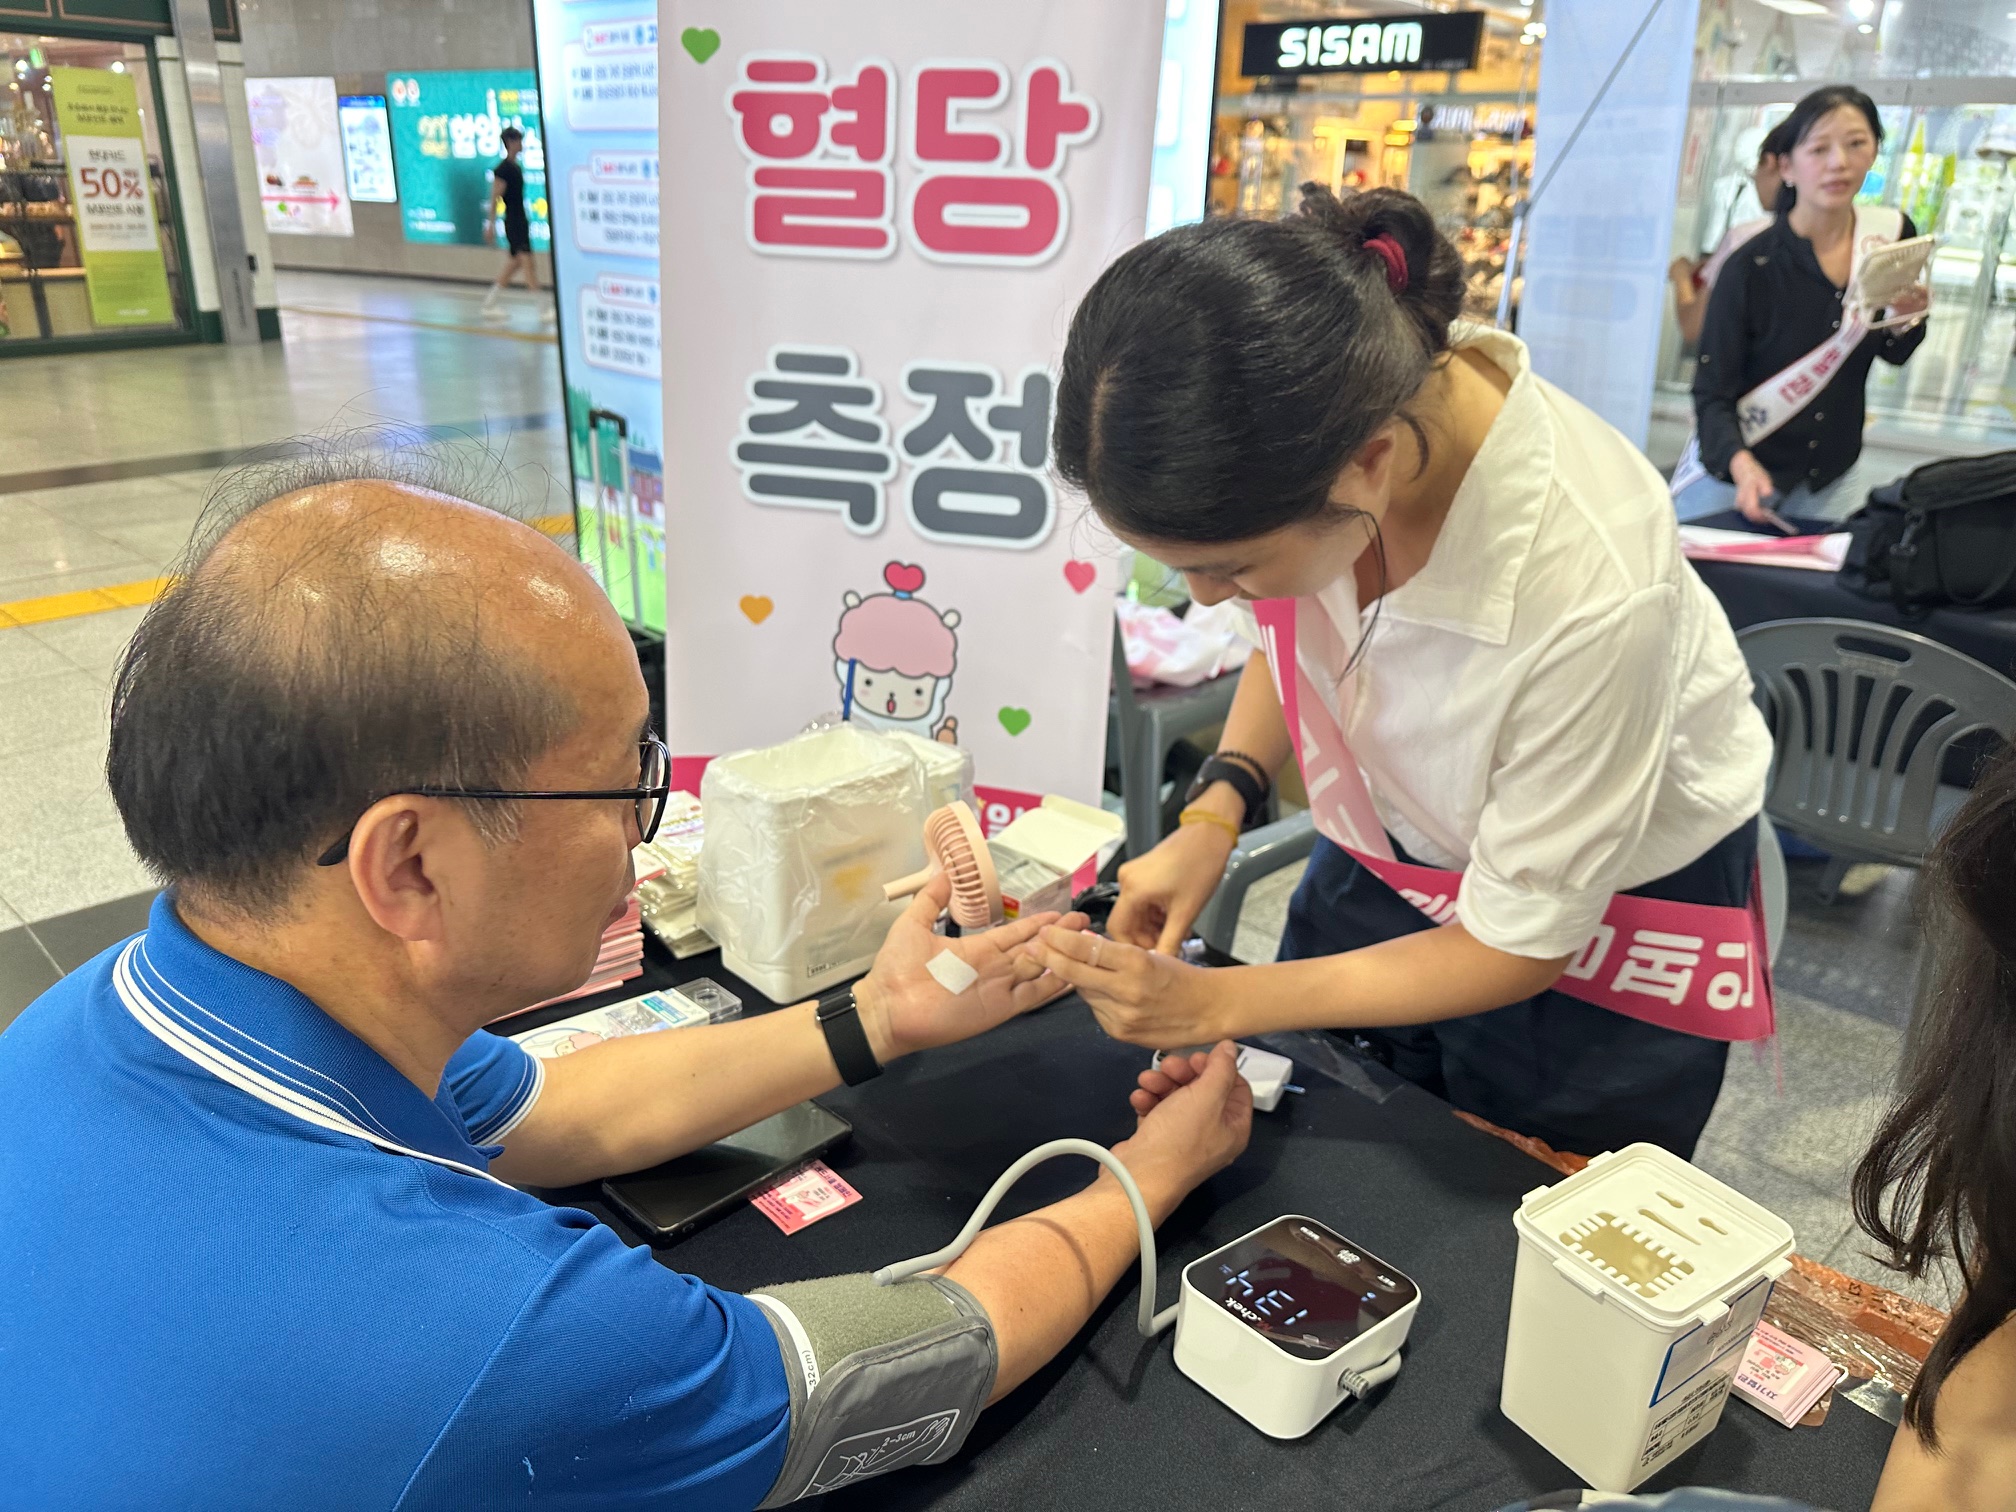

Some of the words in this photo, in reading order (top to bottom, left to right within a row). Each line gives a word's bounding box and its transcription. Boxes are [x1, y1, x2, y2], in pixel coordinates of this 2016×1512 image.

[1278, 22, 1422, 67] SISAM
[729, 55, 1096, 261] 혈당
[80, 166, 144, 199] 50%
[734, 348, 1054, 545] 측정
[882, 1429, 916, 1448] 2-3cm
